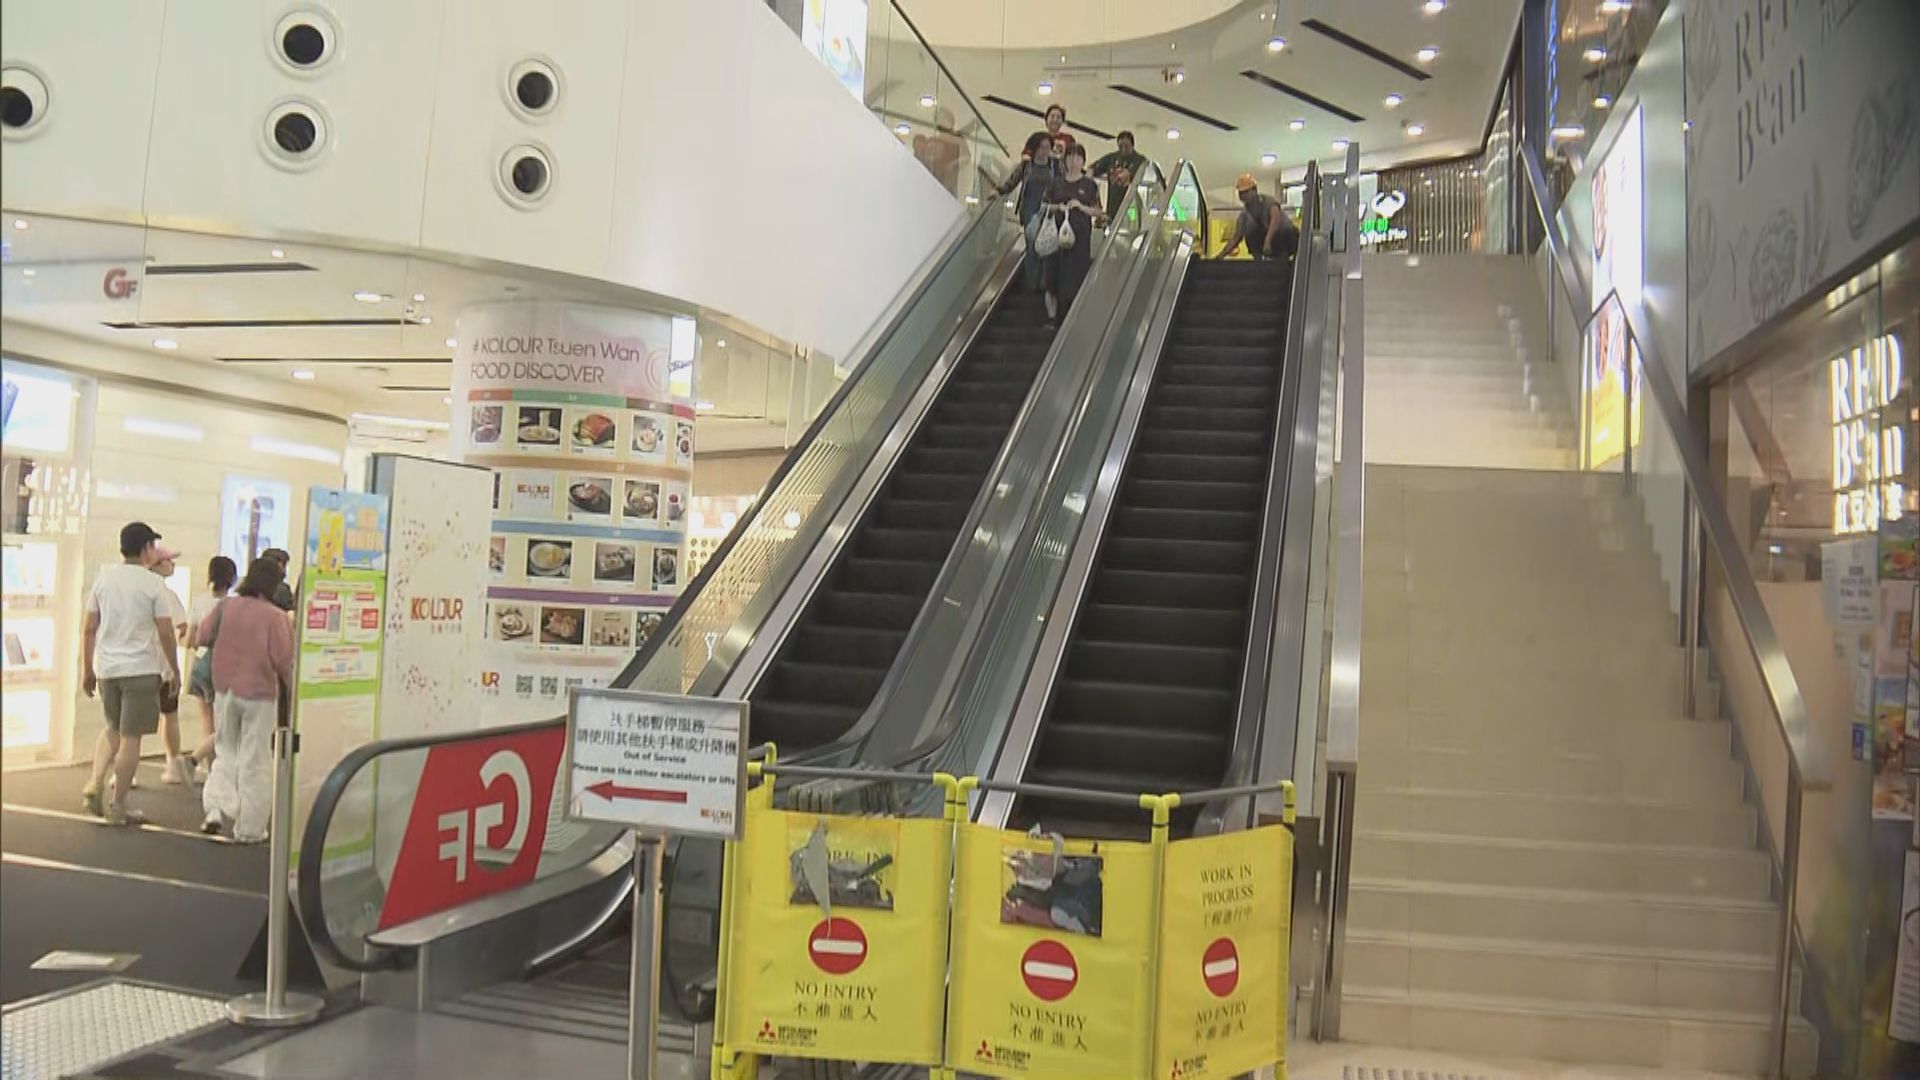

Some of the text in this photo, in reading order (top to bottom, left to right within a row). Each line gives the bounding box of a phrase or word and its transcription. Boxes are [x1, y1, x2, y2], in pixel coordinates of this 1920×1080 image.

[103, 267, 138, 300] GF
[548, 338, 596, 359] Tsuen
[600, 341, 640, 363] Wan
[471, 361, 605, 384] FOOD DISCOVER
[623, 750, 687, 764] Out of Service
[573, 762, 736, 786] Please use the other escalators or lifts
[1200, 863, 1252, 884] WORK IN
[1201, 884, 1254, 909] PROGRESS
[794, 981, 878, 1001] NO ENTRY
[1009, 1001, 1088, 1030] NO ENTRY
[1195, 999, 1249, 1025] NO ENTRY
